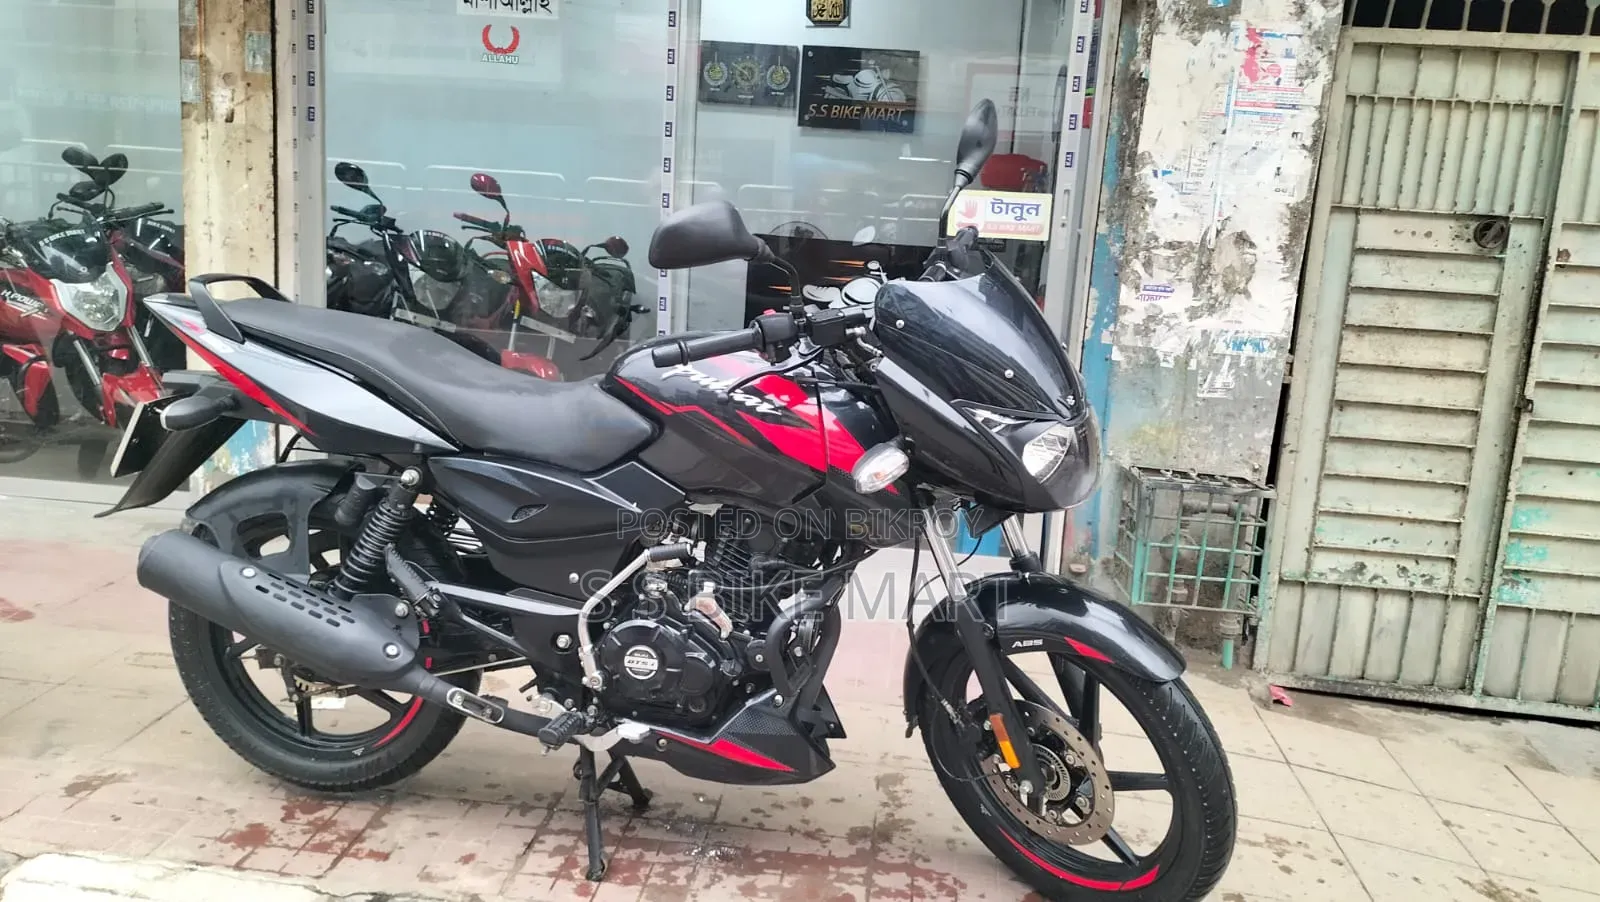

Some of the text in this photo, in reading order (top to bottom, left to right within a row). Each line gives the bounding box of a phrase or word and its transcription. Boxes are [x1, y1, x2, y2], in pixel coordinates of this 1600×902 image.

[481, 53, 519, 64] ALLAHU
[808, 103, 905, 122] S.S BIKE MART
[990, 198, 1041, 221] টানুন
[1011, 638, 1044, 648] ABS
